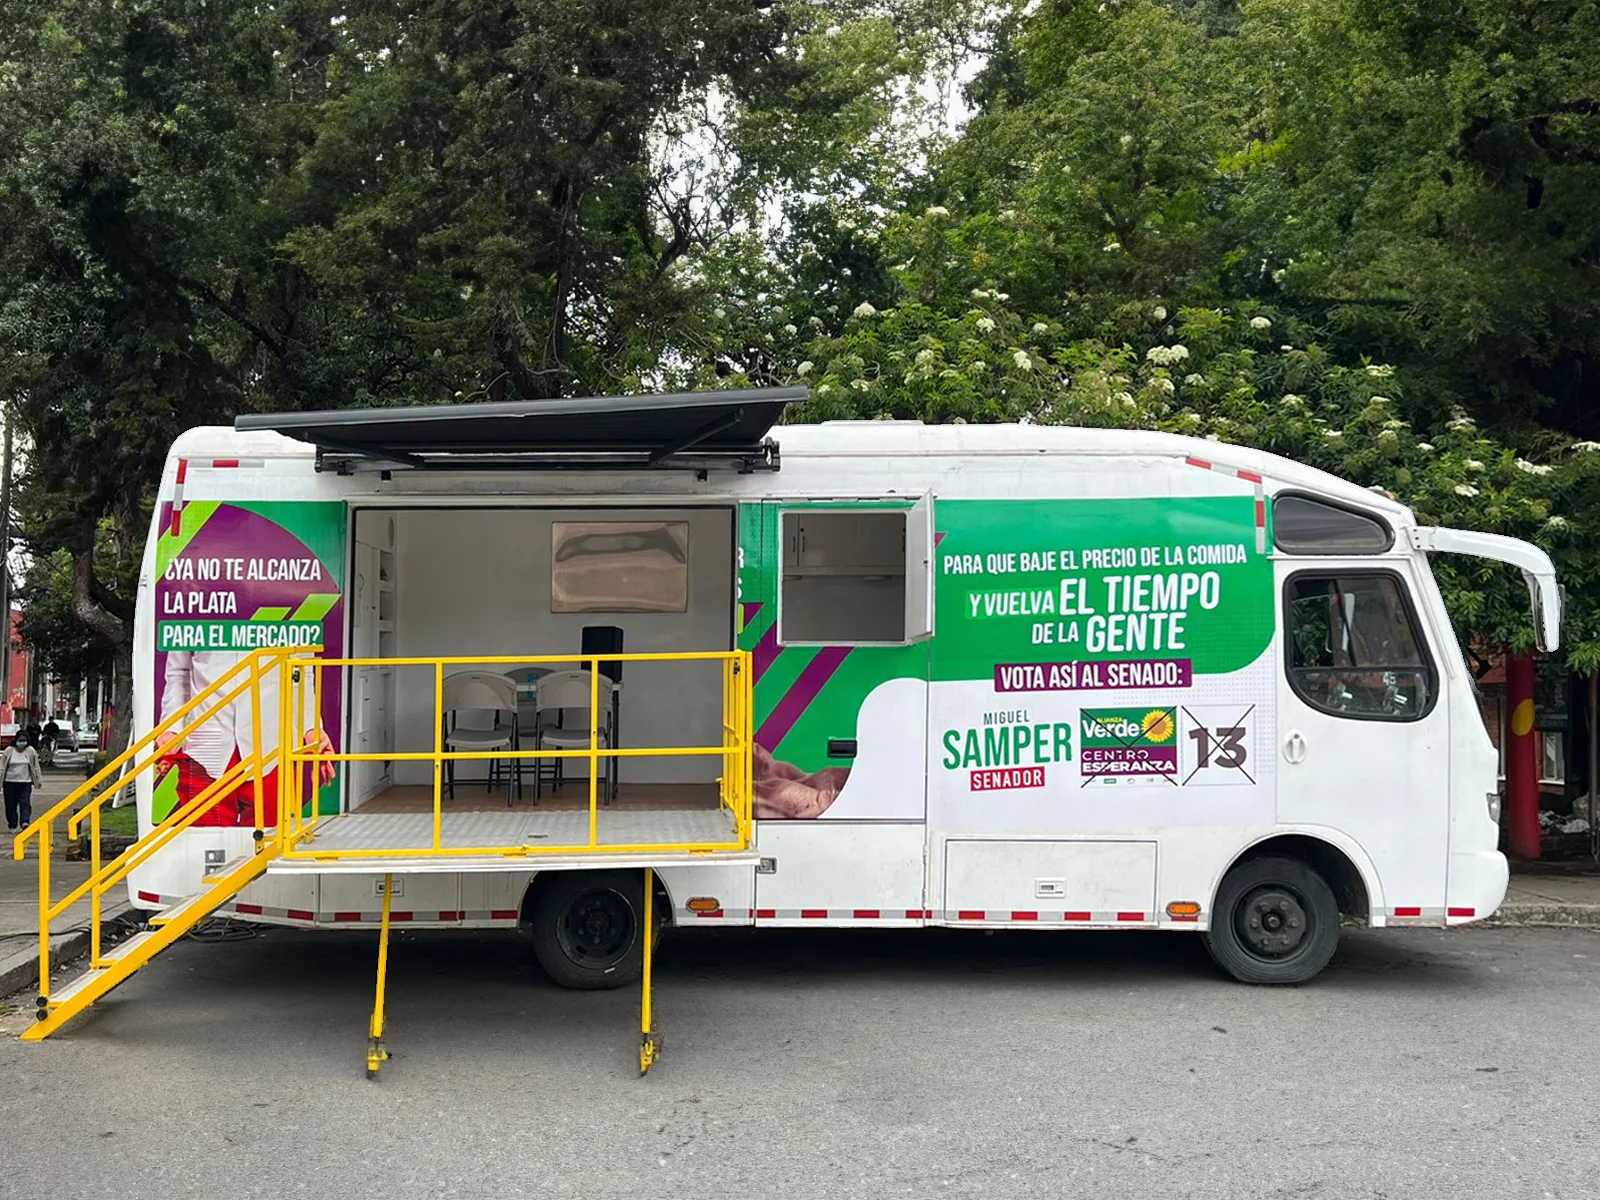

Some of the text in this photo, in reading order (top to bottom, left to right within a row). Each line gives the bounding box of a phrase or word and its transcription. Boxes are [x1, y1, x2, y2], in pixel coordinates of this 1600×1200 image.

[165, 558, 321, 580] ¿YA NO TE ALCANZA
[944, 544, 1247, 575] PARA QUE BAJE EL PRECIO DE LA COMIDA
[164, 591, 237, 614] LA PLATA
[969, 571, 1220, 617] Y VUELVA EL TIEMPO
[163, 625, 321, 648] PARA EL MERCADO?
[1031, 612, 1187, 653] DE LA GENTE
[1001, 660, 1183, 690] VOTA ASÍ AL SENADO:
[983, 709, 1030, 726] MIGUEL
[1081, 718, 1140, 738] Verde
[943, 722, 1073, 770] SAMPER
[1082, 749, 1149, 761] CENTRO
[1188, 727, 1247, 769] 13
[1082, 760, 1176, 773] ESPERANZA
[973, 769, 1042, 790] SENADOR
